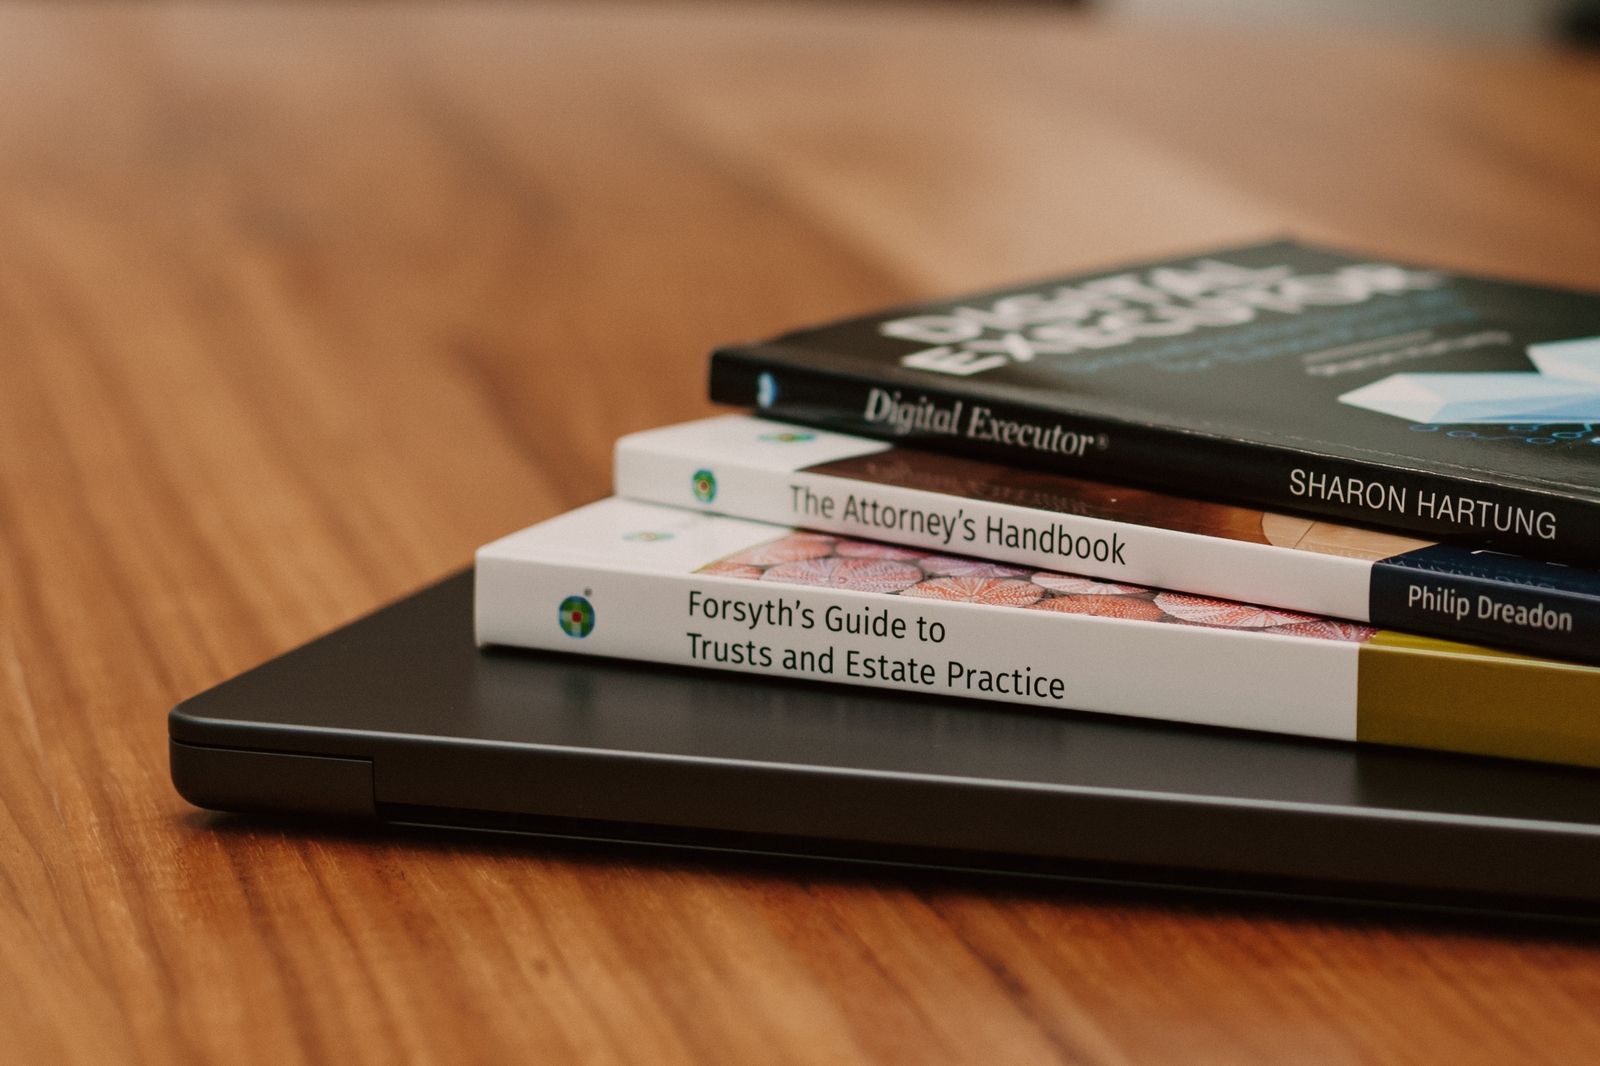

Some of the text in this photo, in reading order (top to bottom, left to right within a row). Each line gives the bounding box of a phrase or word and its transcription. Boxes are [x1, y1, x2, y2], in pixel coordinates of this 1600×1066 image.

[863, 387, 963, 436] Digital
[789, 484, 835, 520] The
[985, 516, 1128, 566] Handbook
[1289, 468, 1557, 541] SHARON HARTUNG
[824, 603, 907, 640] Guide
[915, 617, 946, 644] to
[1408, 584, 1573, 633] Philip Dreadon
[686, 632, 1066, 700] Trusts and Estate Practice
